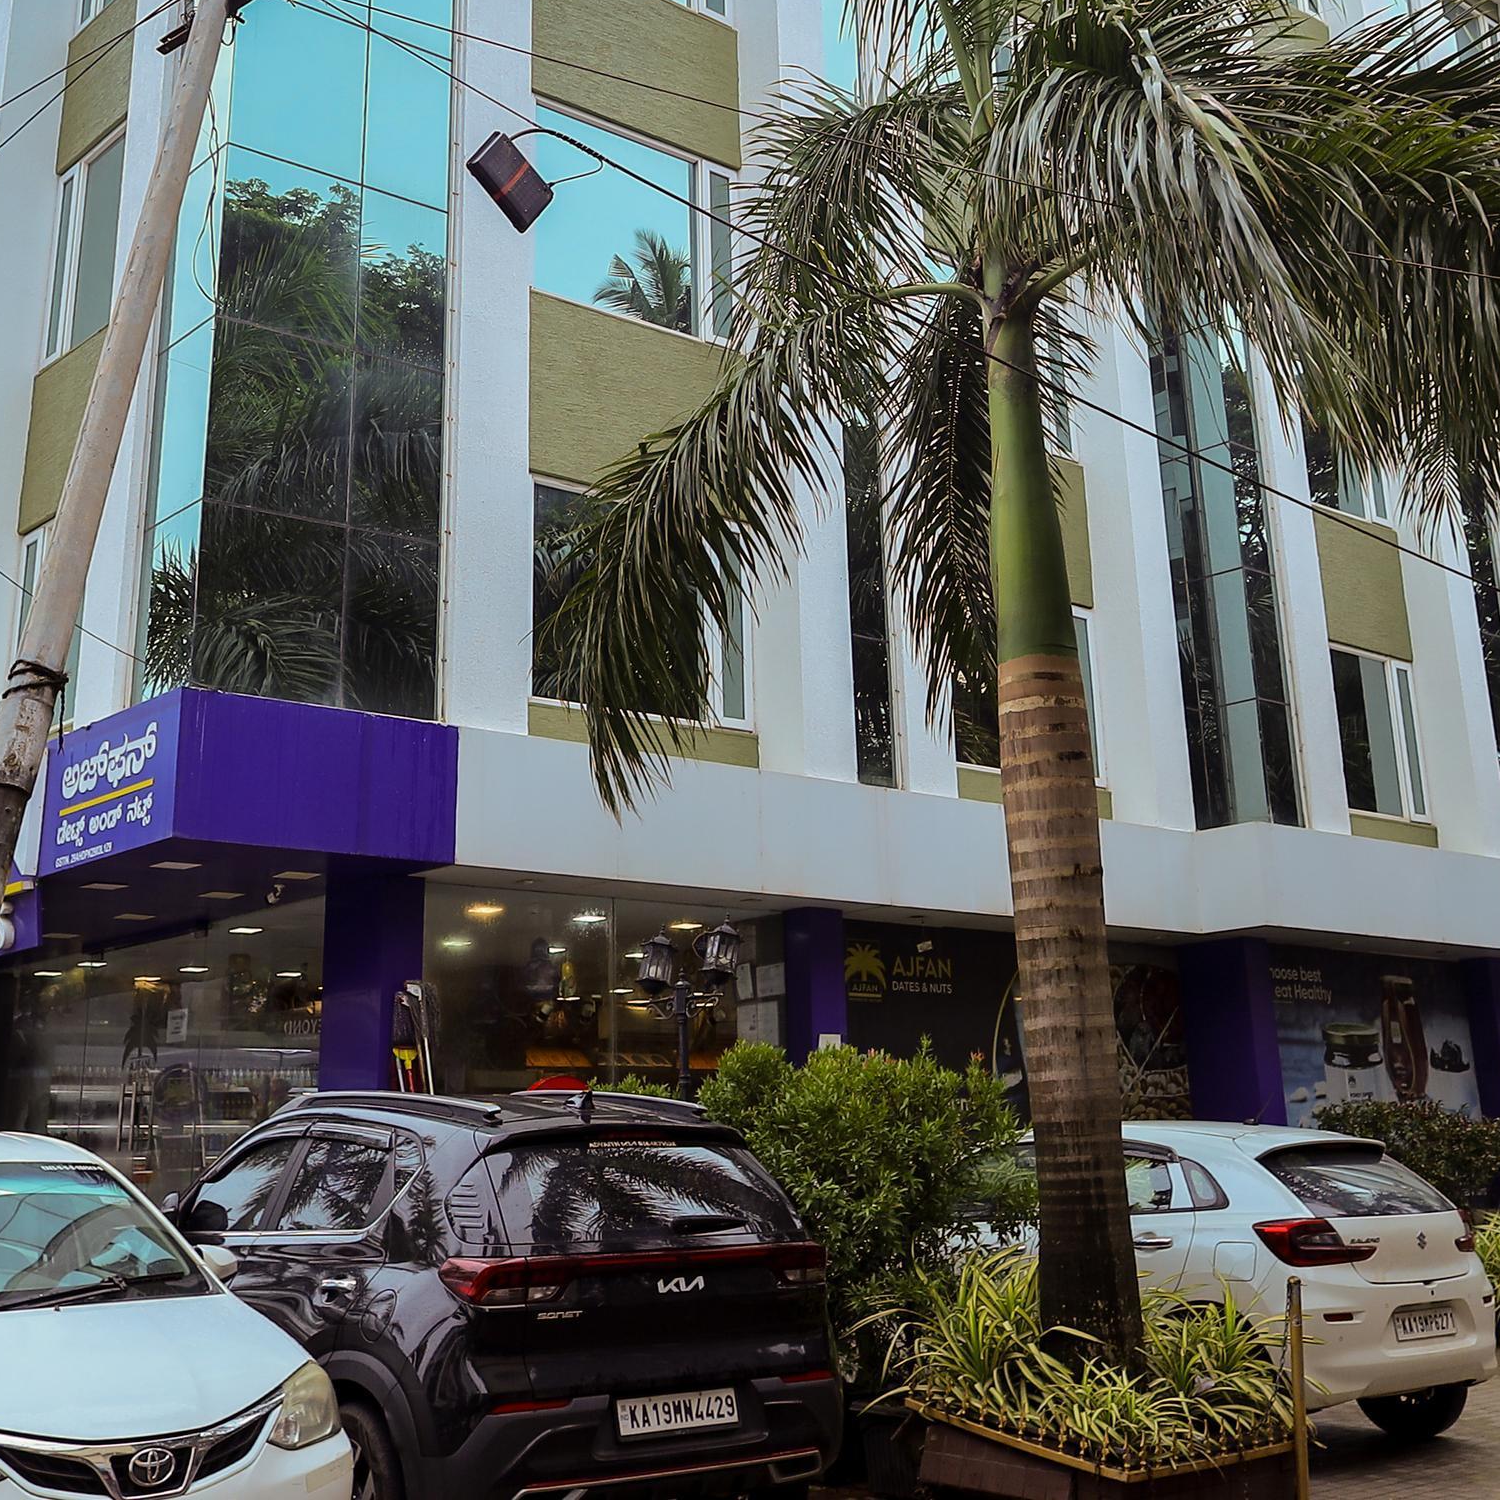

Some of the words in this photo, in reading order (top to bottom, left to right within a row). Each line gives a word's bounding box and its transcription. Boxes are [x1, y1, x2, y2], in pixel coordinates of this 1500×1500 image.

[892, 955, 952, 979] AJFAN
[1300, 966, 1322, 983] best
[892, 980, 920, 993] DATES
[921, 983, 929, 993] &
[929, 983, 953, 995] NUTS
[1275, 986, 1293, 999] eat
[1294, 984, 1333, 1005] Healthy
[628, 1394, 736, 1430] KA19MN4429
